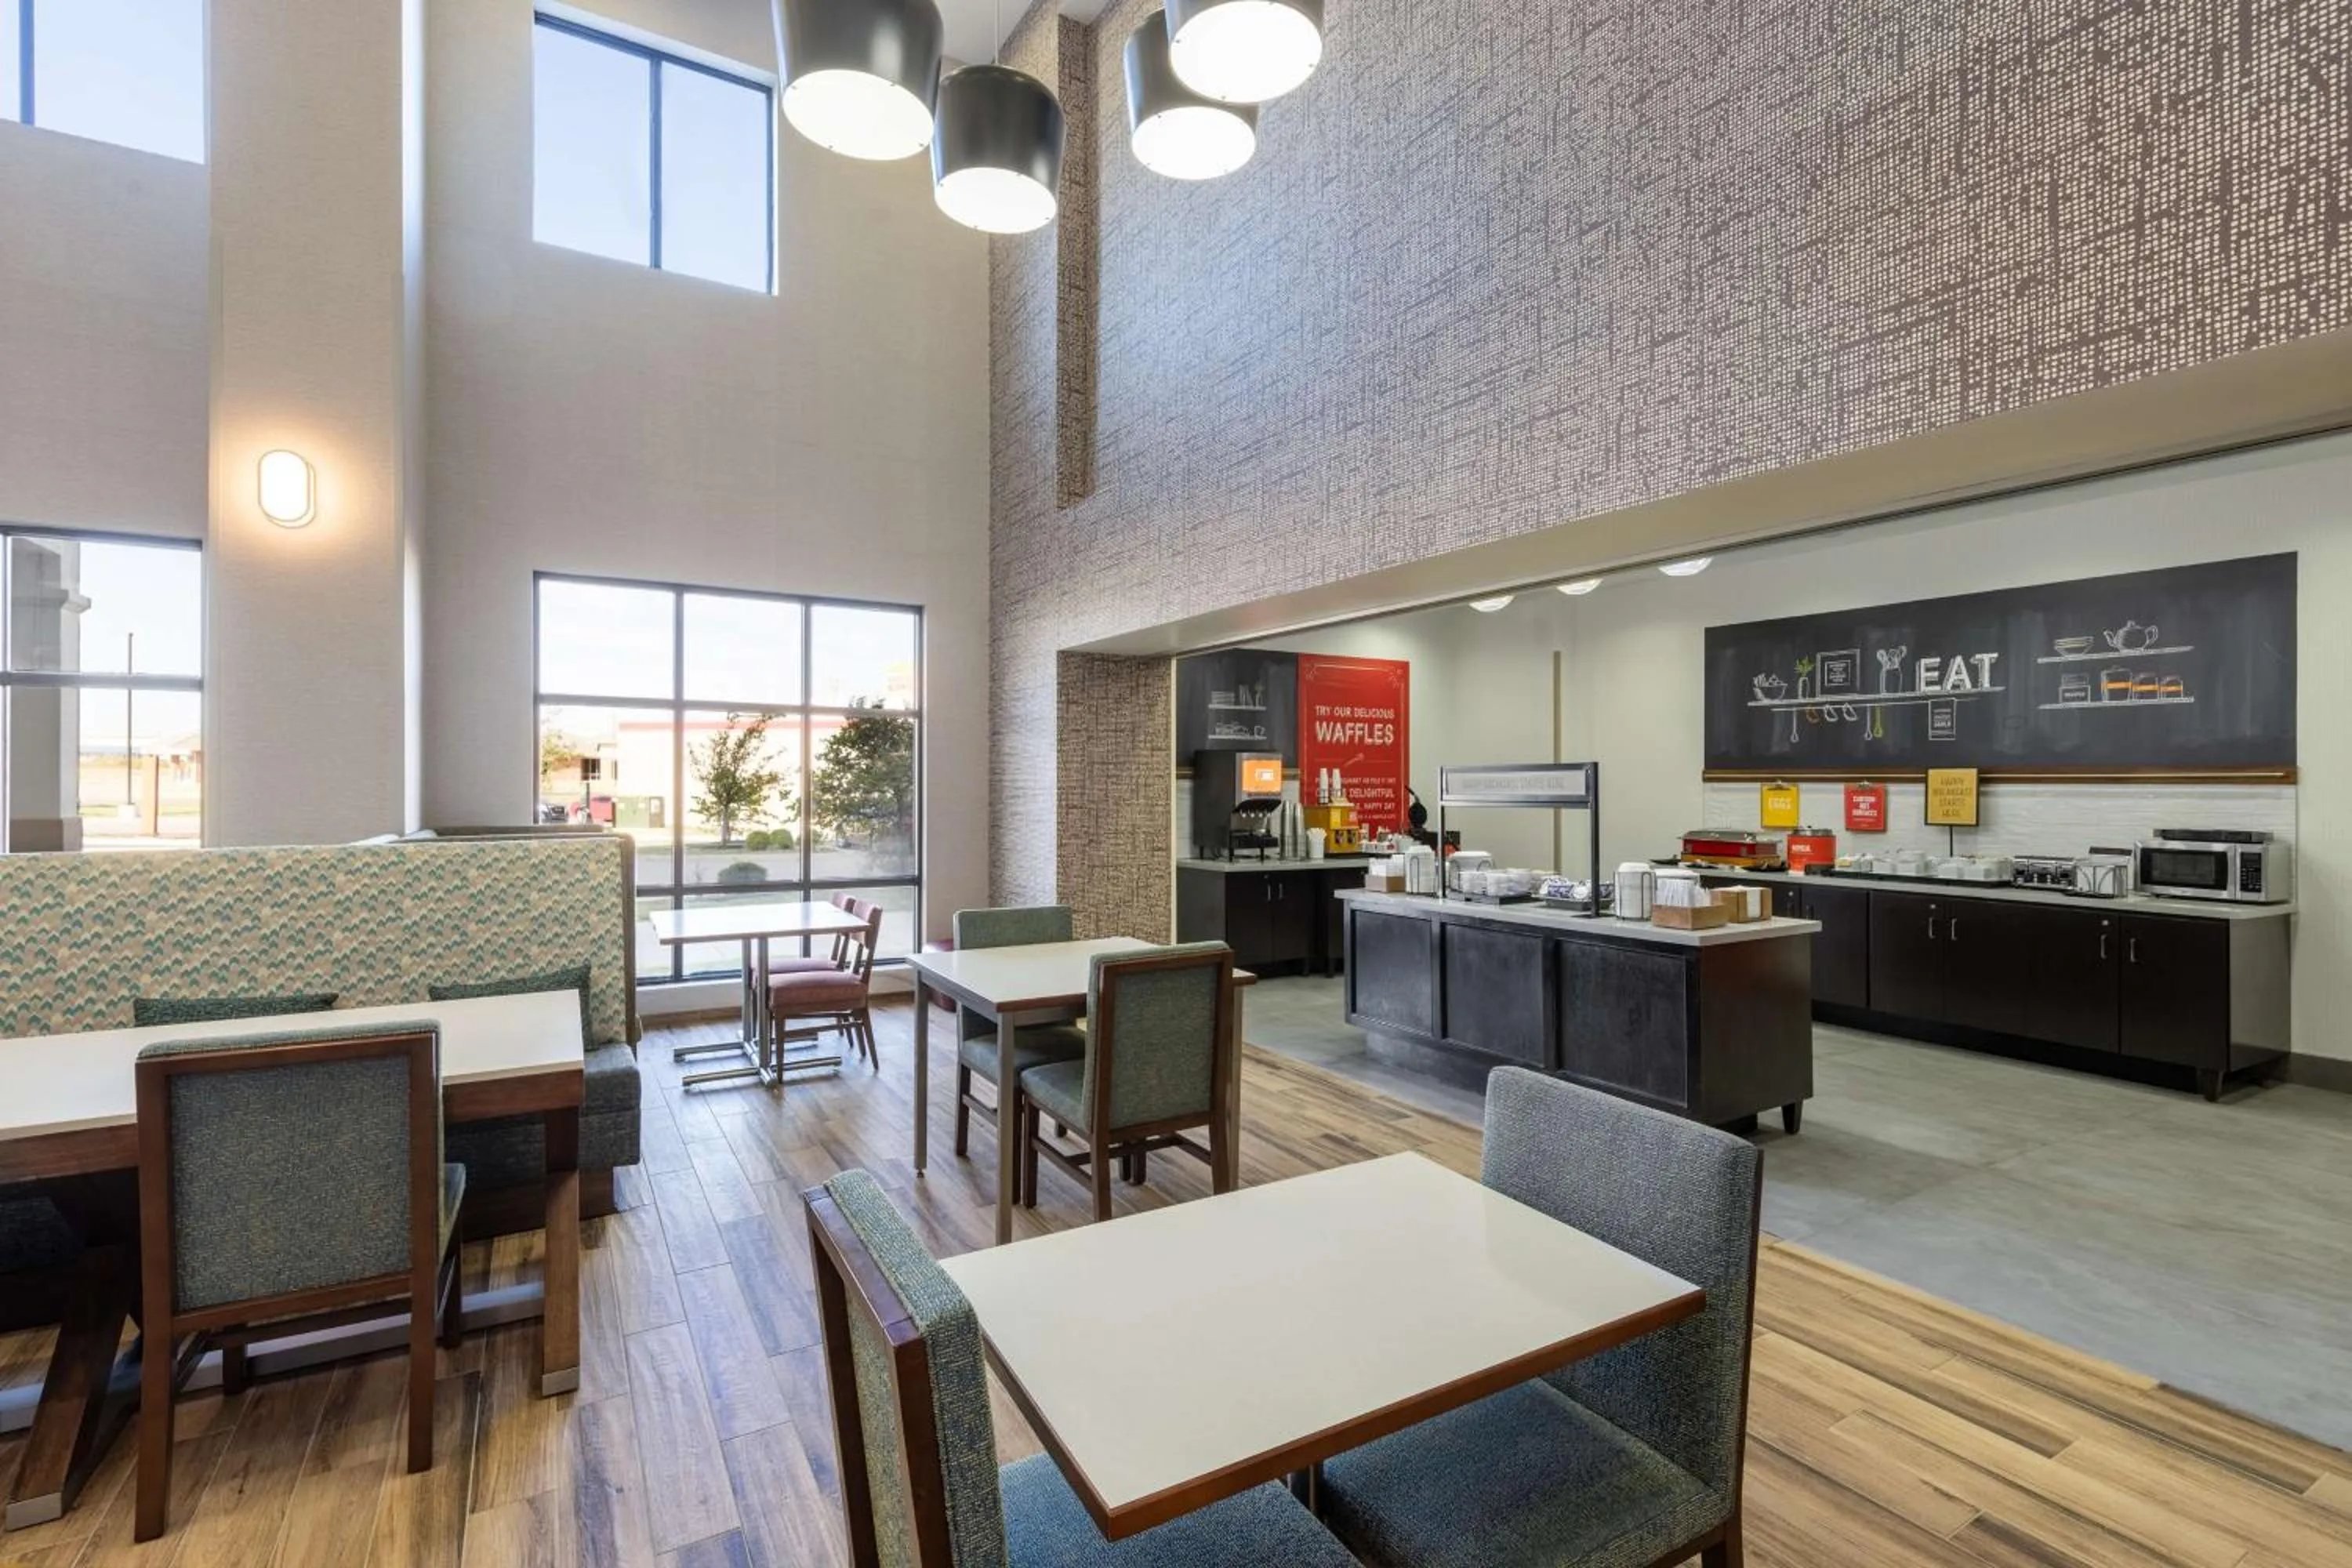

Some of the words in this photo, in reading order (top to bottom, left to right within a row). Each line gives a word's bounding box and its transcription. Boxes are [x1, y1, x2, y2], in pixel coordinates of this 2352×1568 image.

[1915, 652, 1998, 691] EAT
[1316, 705, 1330, 716] TRY
[1334, 706, 1352, 717] OUR
[1354, 708, 1395, 719] DELICIOUS
[1316, 720, 1394, 746] WAFFLES
